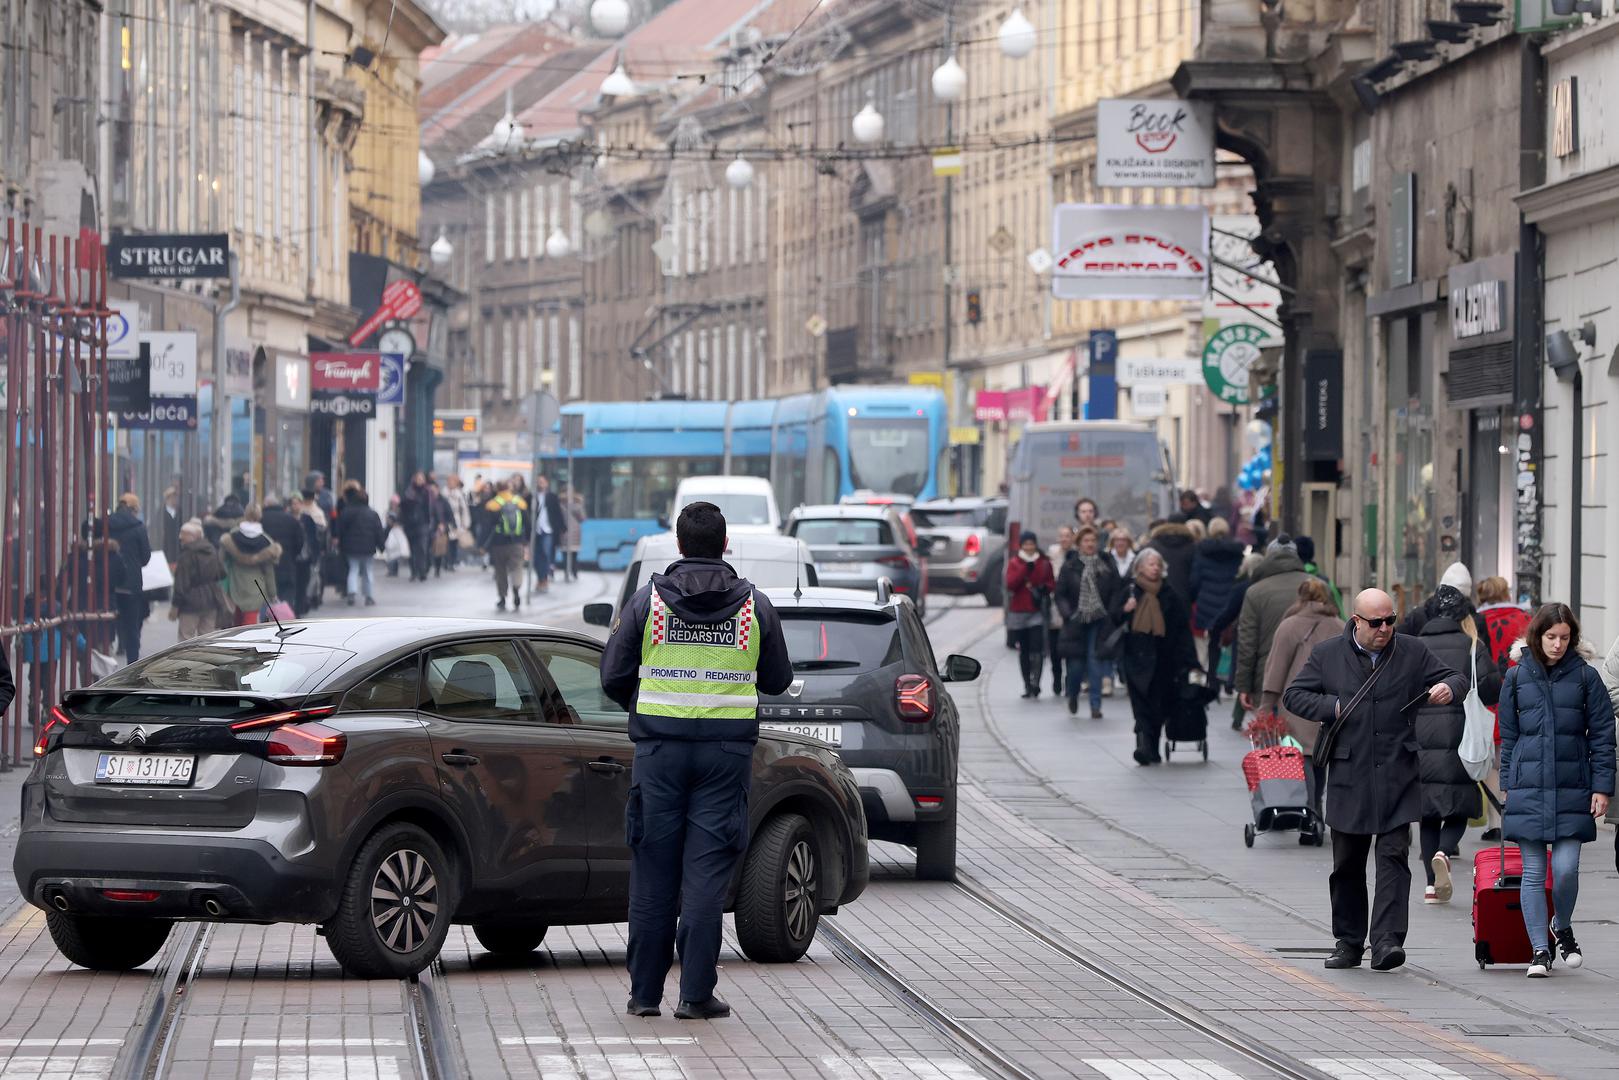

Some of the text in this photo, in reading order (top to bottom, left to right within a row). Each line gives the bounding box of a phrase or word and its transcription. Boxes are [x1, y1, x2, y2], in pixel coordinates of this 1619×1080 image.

[1127, 104, 1187, 133] Book
[119, 247, 225, 266] STRUGAR
[148, 267, 176, 275] SINCE
[314, 360, 373, 384] Triumph
[1222, 385, 1264, 403] PU
[669, 630, 734, 644] REDARSTVO
[651, 669, 751, 682] PROMETNO REDARSTVO
[762, 708, 842, 716] USTER
[107, 757, 124, 776] SI
